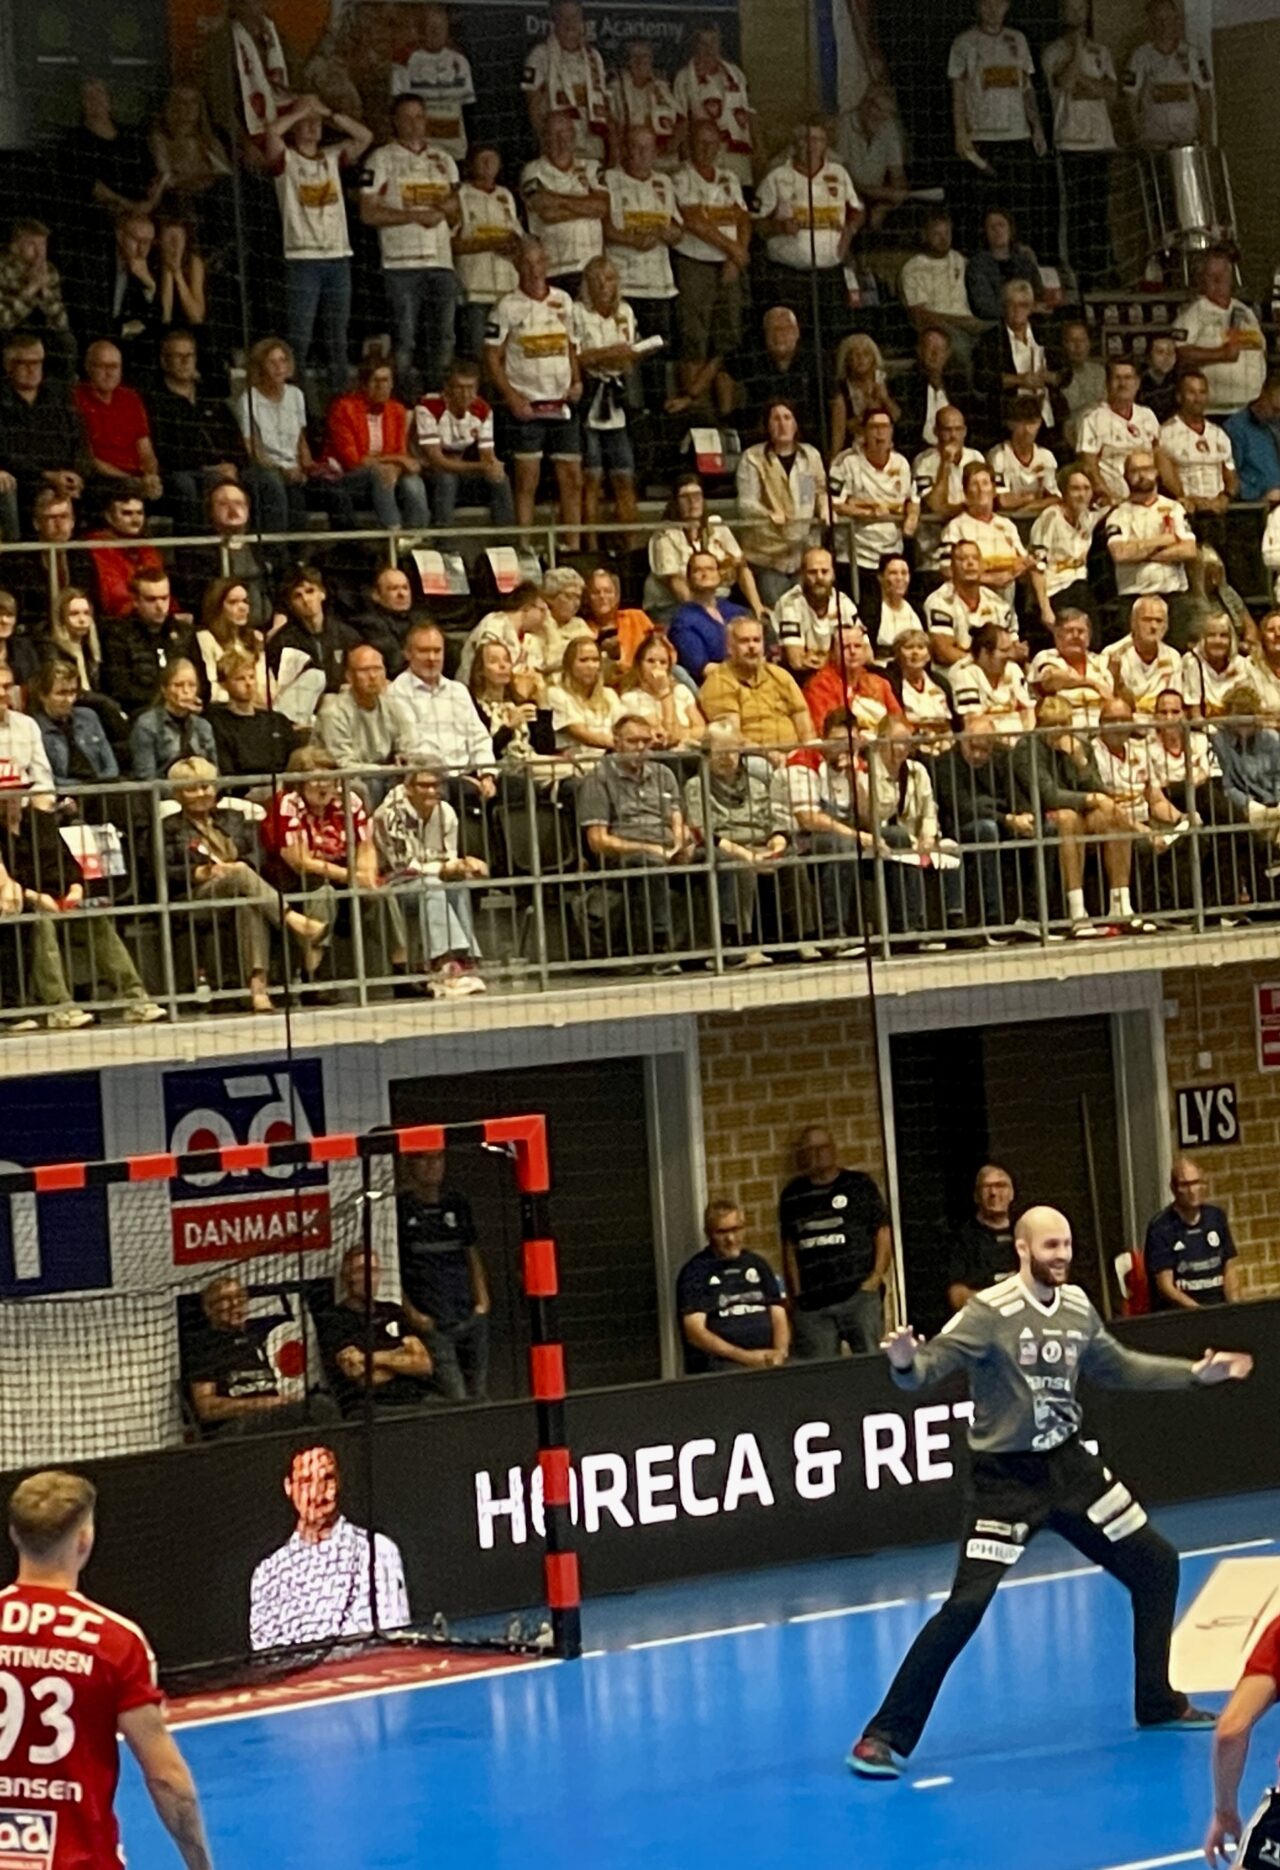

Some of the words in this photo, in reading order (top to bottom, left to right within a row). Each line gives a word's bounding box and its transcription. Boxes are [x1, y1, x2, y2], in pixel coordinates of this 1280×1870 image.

[600, 17, 685, 44] Academy
[1179, 1087, 1237, 1144] LYS
[184, 1208, 321, 1250] DANMARK
[793, 1421, 842, 1499] &
